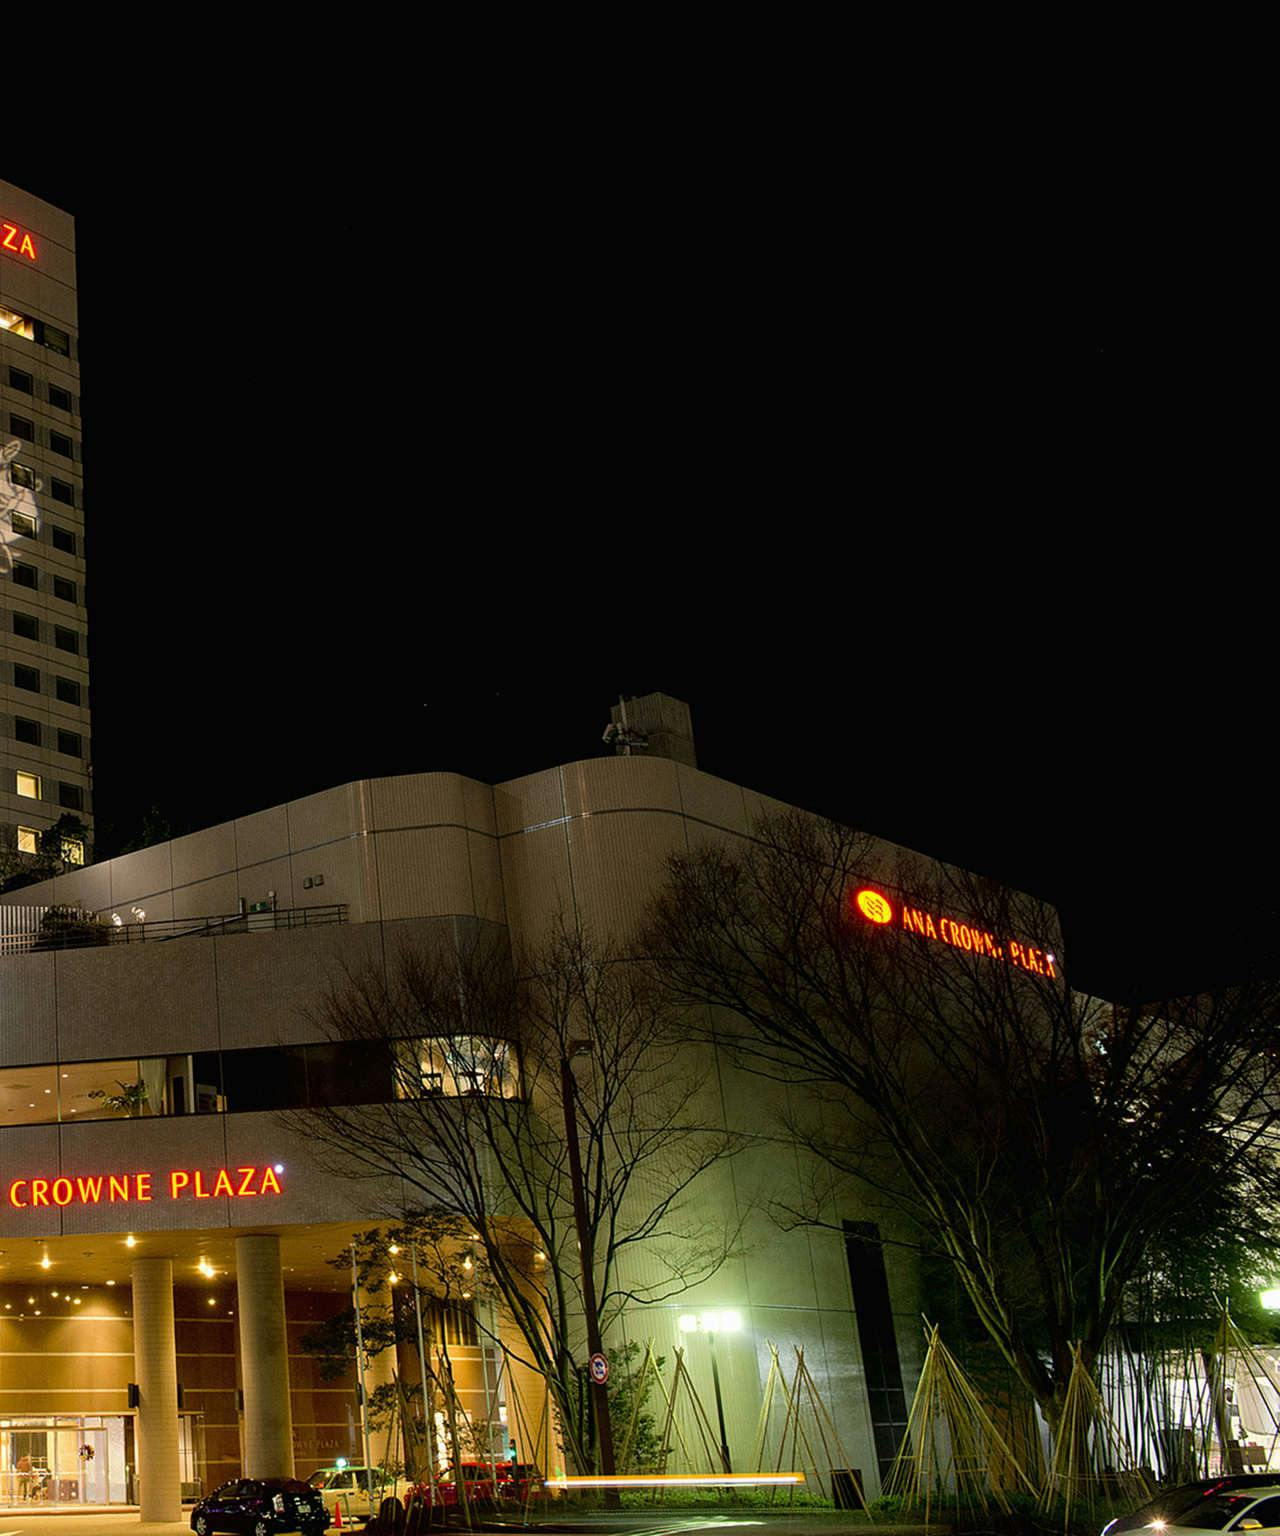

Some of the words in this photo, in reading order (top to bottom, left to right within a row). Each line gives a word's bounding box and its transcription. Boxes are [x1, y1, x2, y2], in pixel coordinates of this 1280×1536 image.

[902, 906, 938, 940] ANA
[7, 1172, 153, 1209] CROWNE
[169, 1165, 283, 1200] PLAZA
